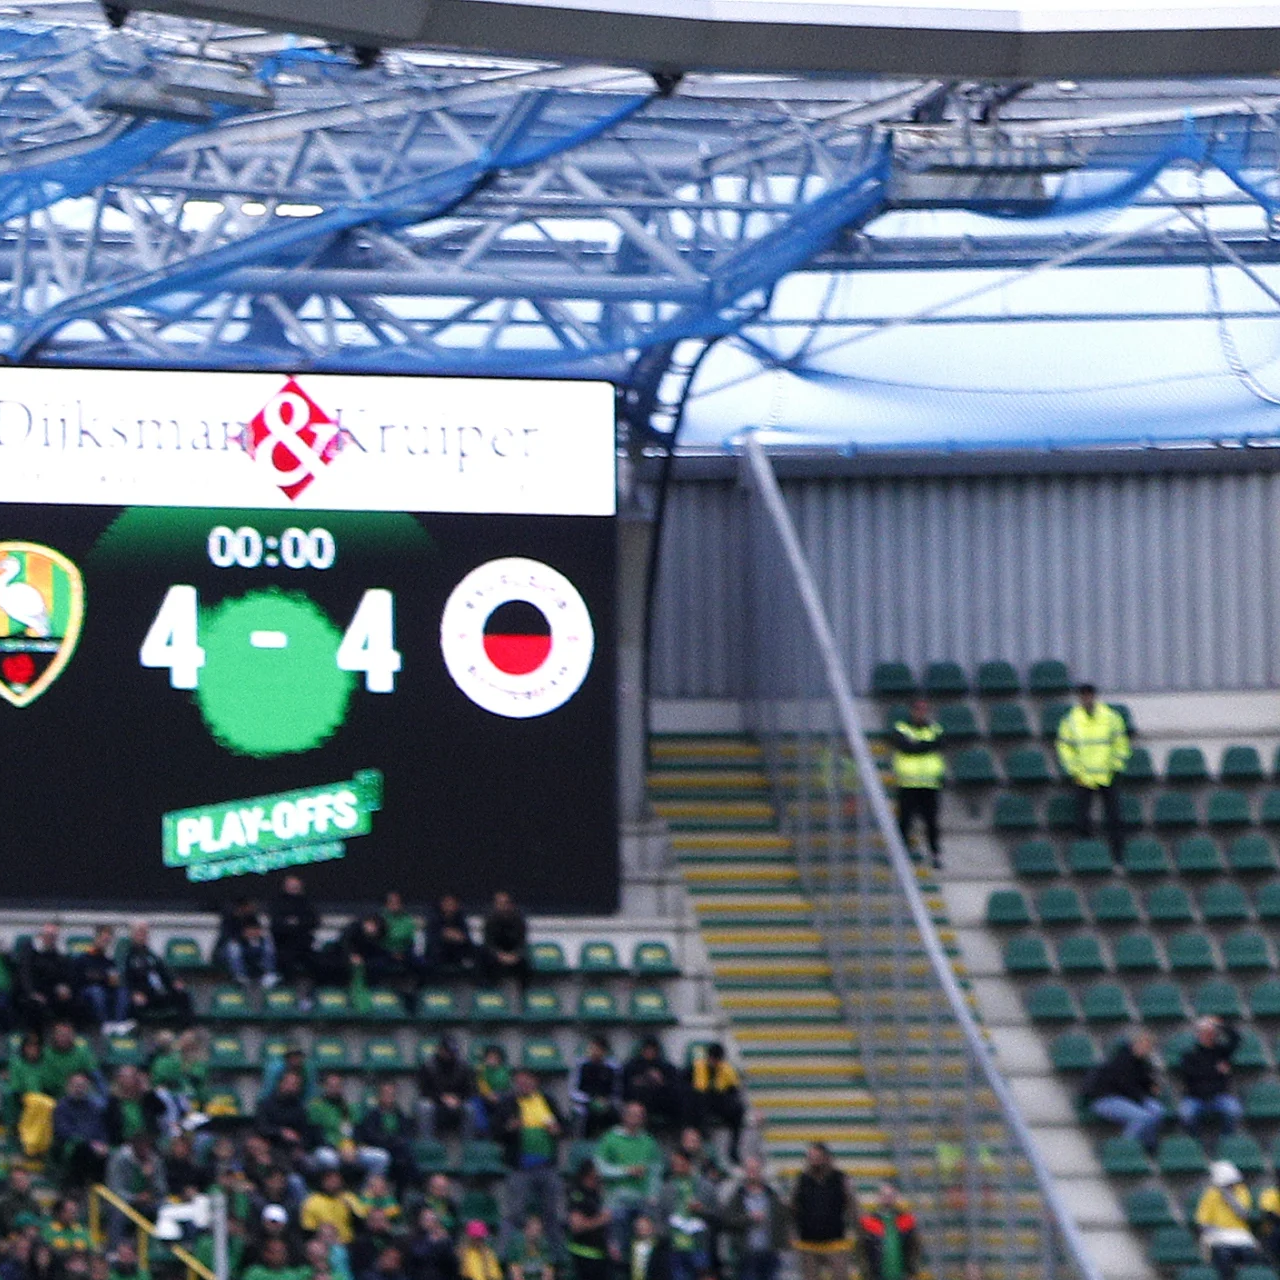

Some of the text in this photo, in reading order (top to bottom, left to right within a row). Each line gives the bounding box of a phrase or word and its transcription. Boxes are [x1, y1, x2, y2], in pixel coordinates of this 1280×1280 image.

[208, 526, 335, 569] 00:00
[140, 584, 206, 689] 4
[337, 588, 402, 693] 4
[176, 789, 359, 857] PLAY-OFFS
